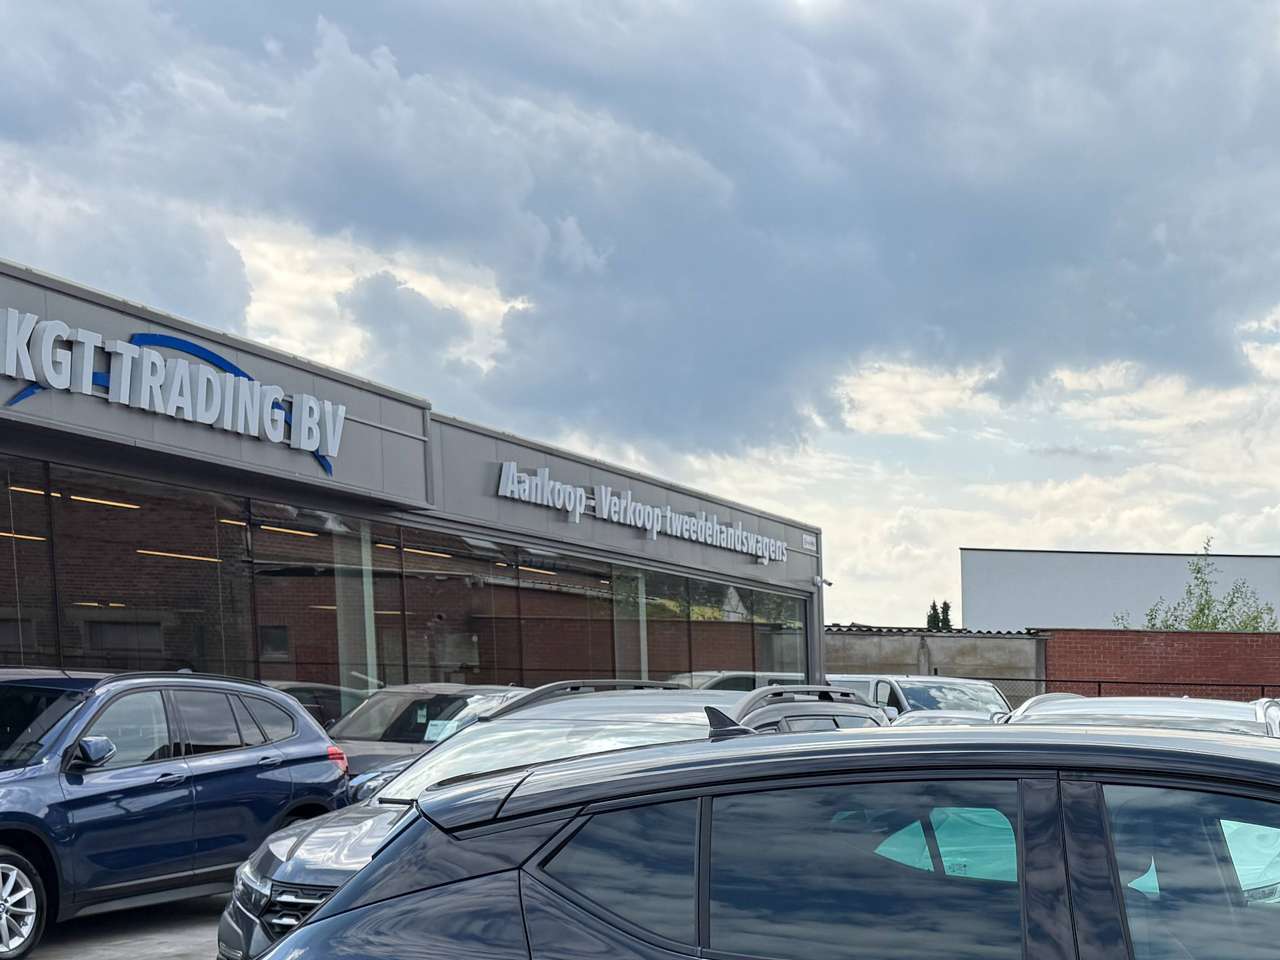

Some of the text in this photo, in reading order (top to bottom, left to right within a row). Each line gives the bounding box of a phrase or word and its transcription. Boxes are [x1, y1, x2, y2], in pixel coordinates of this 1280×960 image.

[5, 308, 346, 457] KGT TRADING BV
[595, 485, 661, 540] Verkoop
[666, 505, 788, 564] tweedehandswagens
